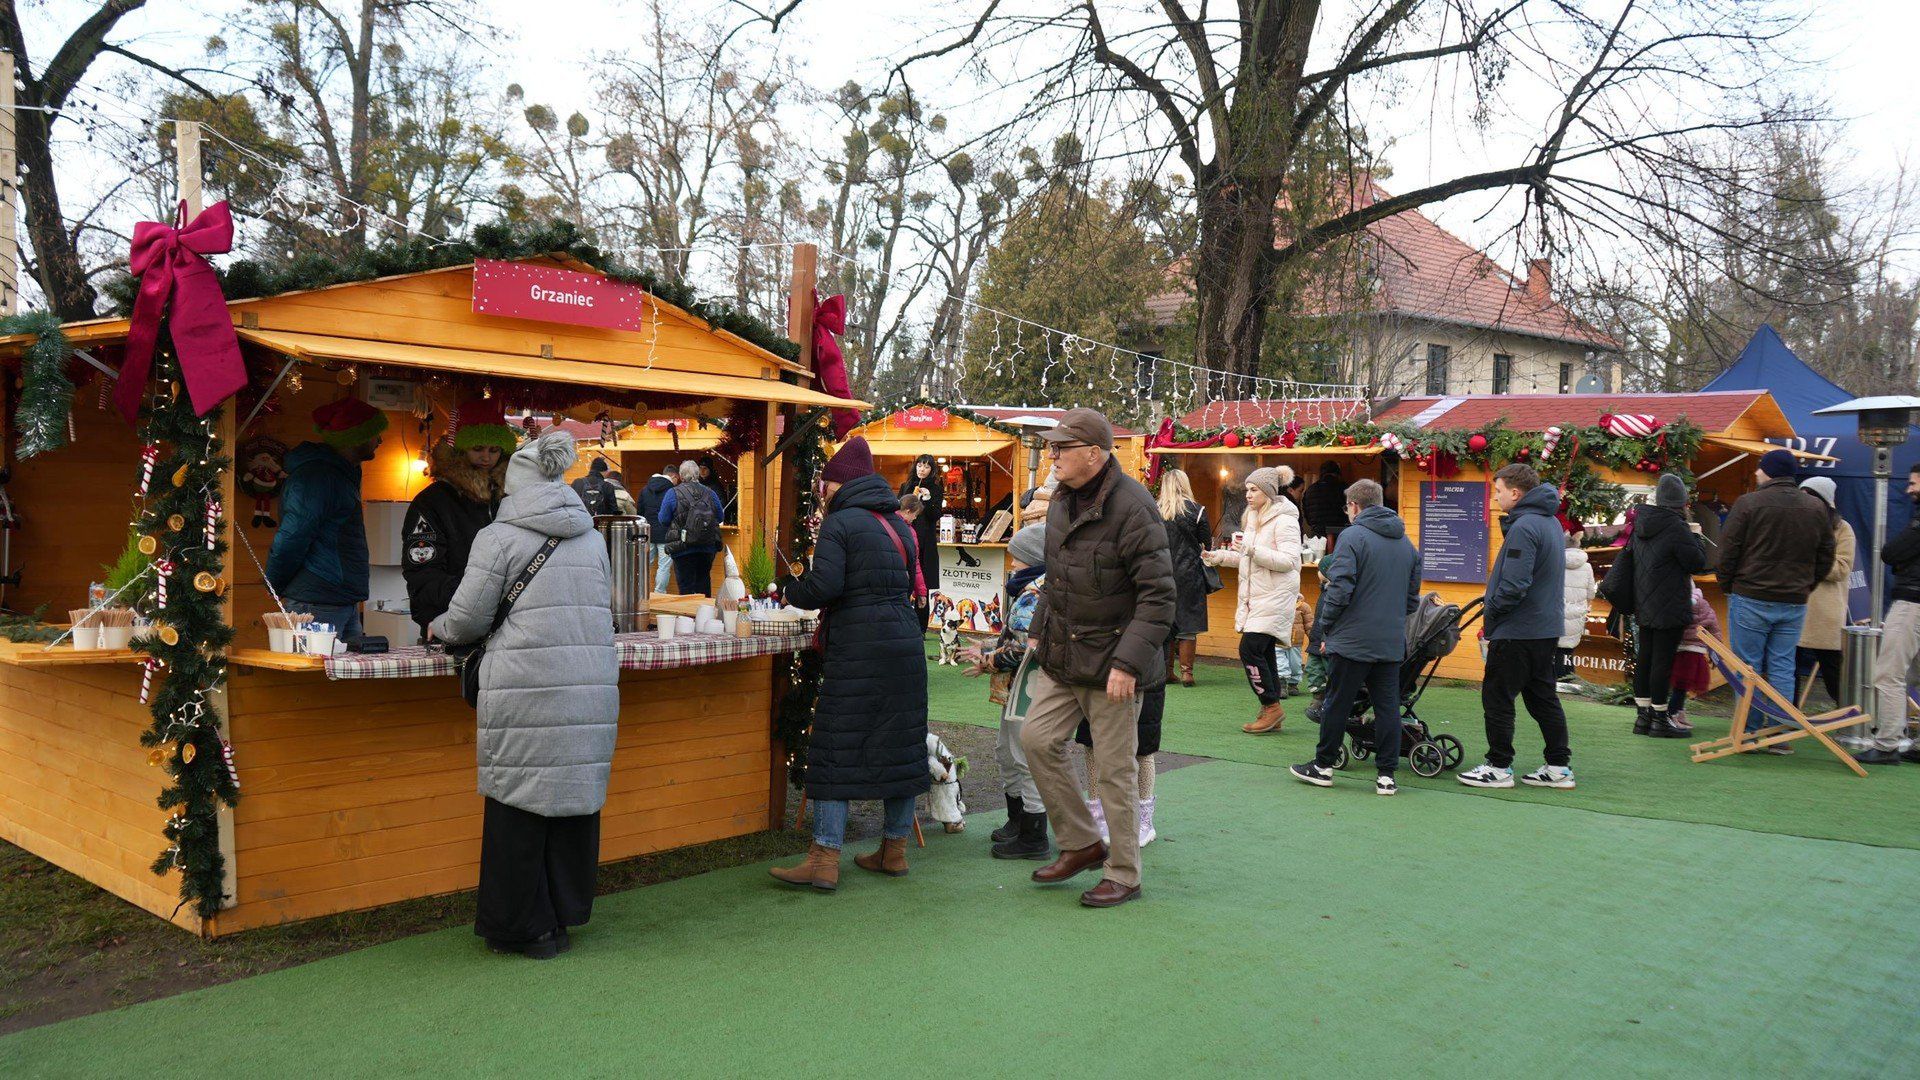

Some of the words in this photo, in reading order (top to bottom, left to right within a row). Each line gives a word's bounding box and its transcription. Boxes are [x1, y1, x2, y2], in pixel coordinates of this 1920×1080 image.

[530, 284, 594, 308] Grzaniec
[526, 553, 546, 575] RKO
[942, 568, 971, 580] ZŁOTY
[971, 571, 992, 581] PIES
[507, 581, 524, 603] RKO
[952, 581, 980, 590] BROWAR
[1563, 654, 1626, 672] KOCHARZ
[1246, 665, 1265, 695] FILA
